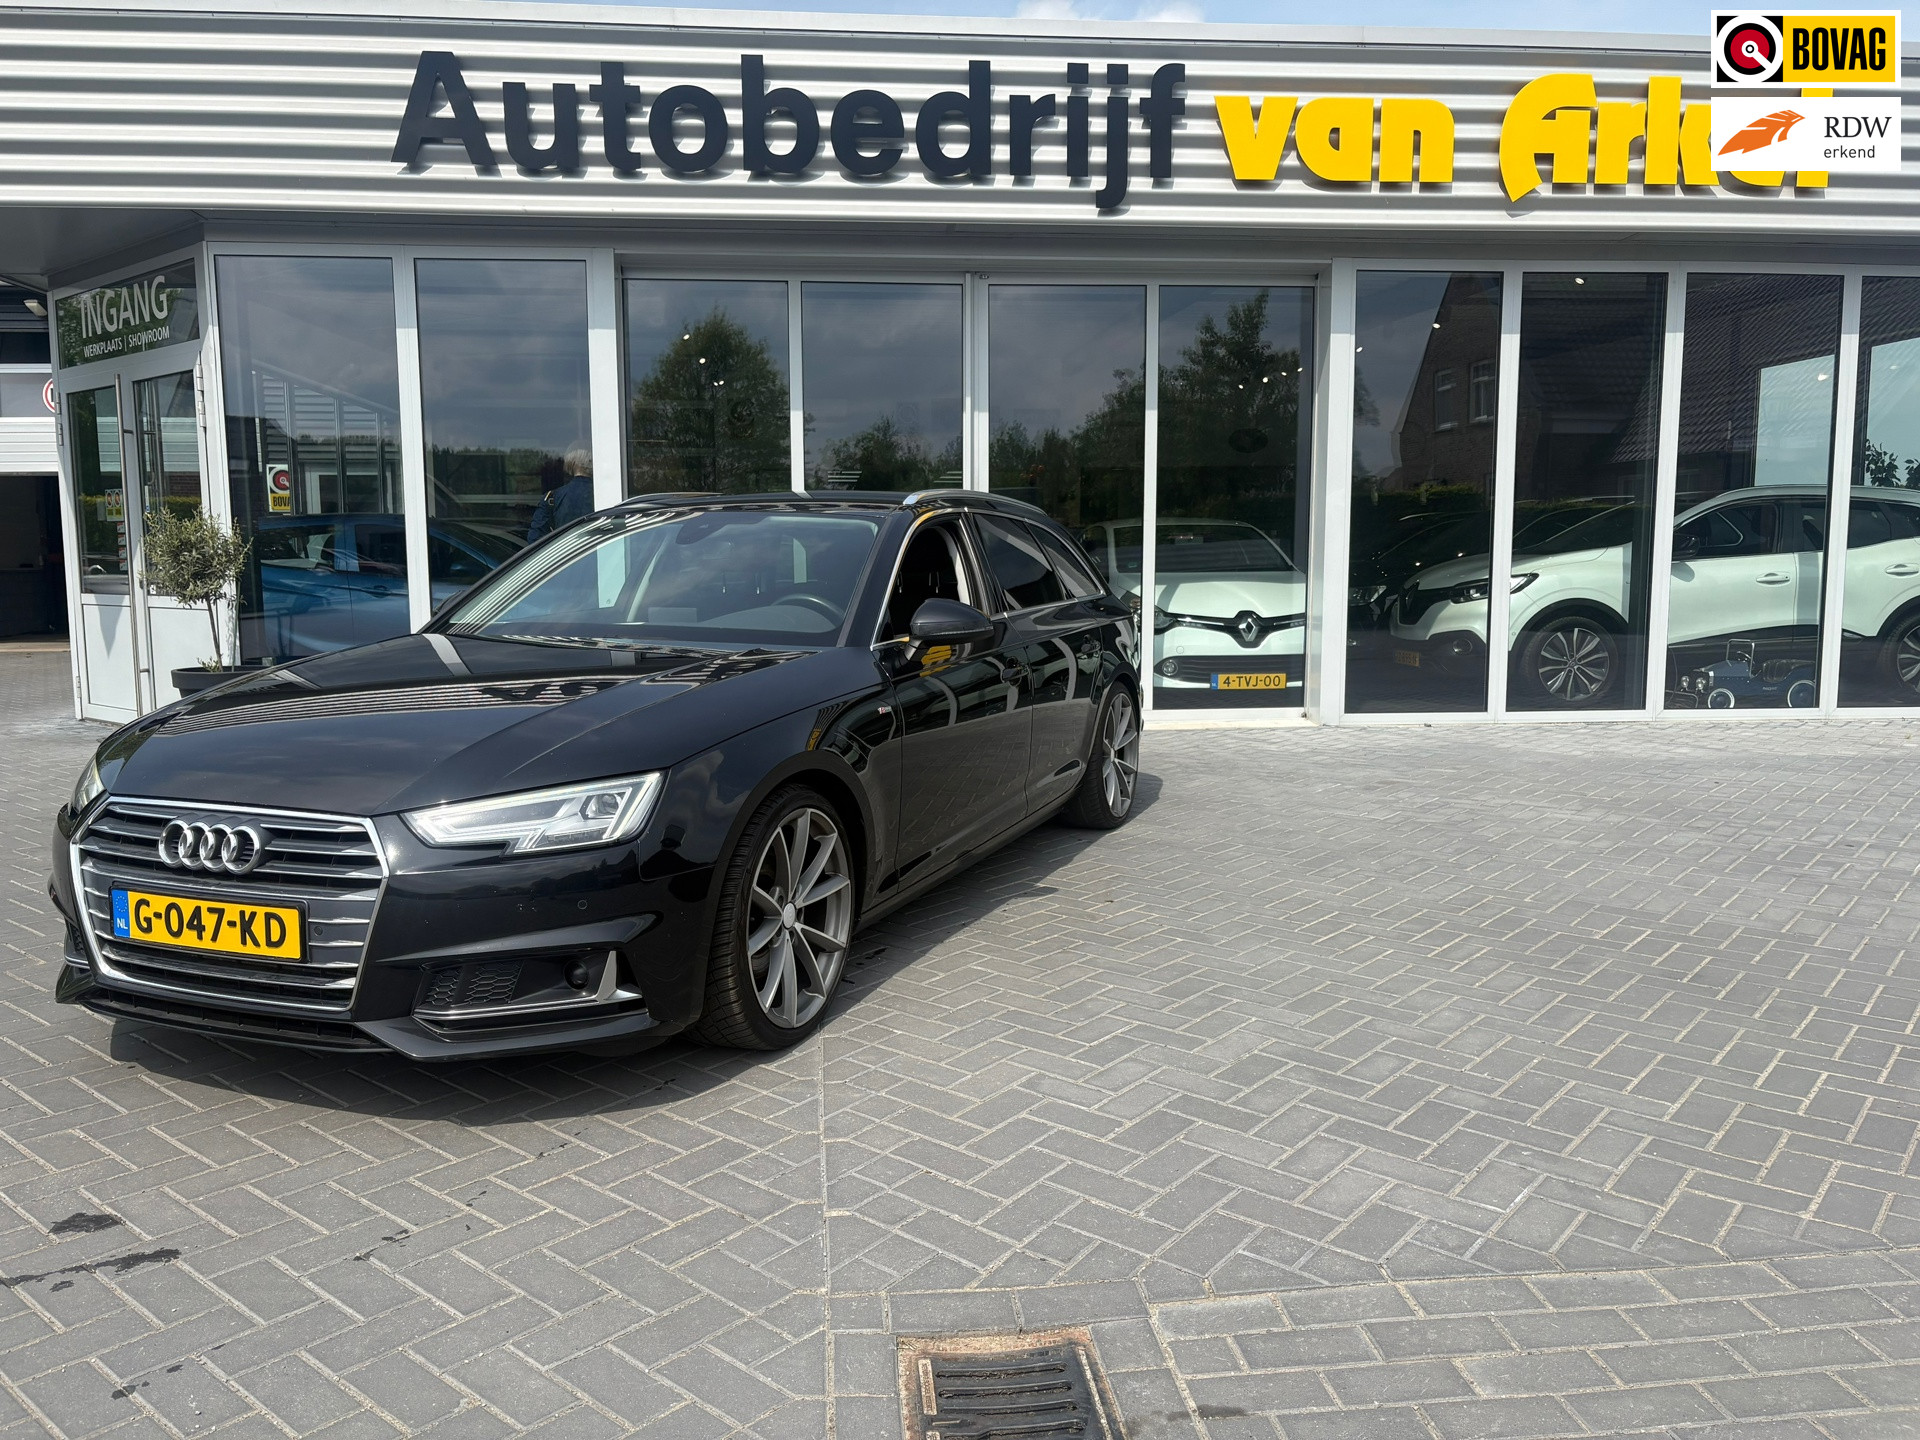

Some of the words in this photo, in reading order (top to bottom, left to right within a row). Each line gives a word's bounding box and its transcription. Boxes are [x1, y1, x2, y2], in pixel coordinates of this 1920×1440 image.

[391, 50, 1186, 209] Autobedrijf
[1213, 95, 1455, 183] van
[1499, 73, 1834, 203] Ark
[80, 275, 168, 339] INGANG
[83, 337, 123, 358] WERKPLAATS
[128, 325, 170, 348] SHOWROOM
[1222, 675, 1281, 688] 4-TVJ-00
[116, 917, 129, 930] NL
[134, 898, 287, 948] G-047-KD
